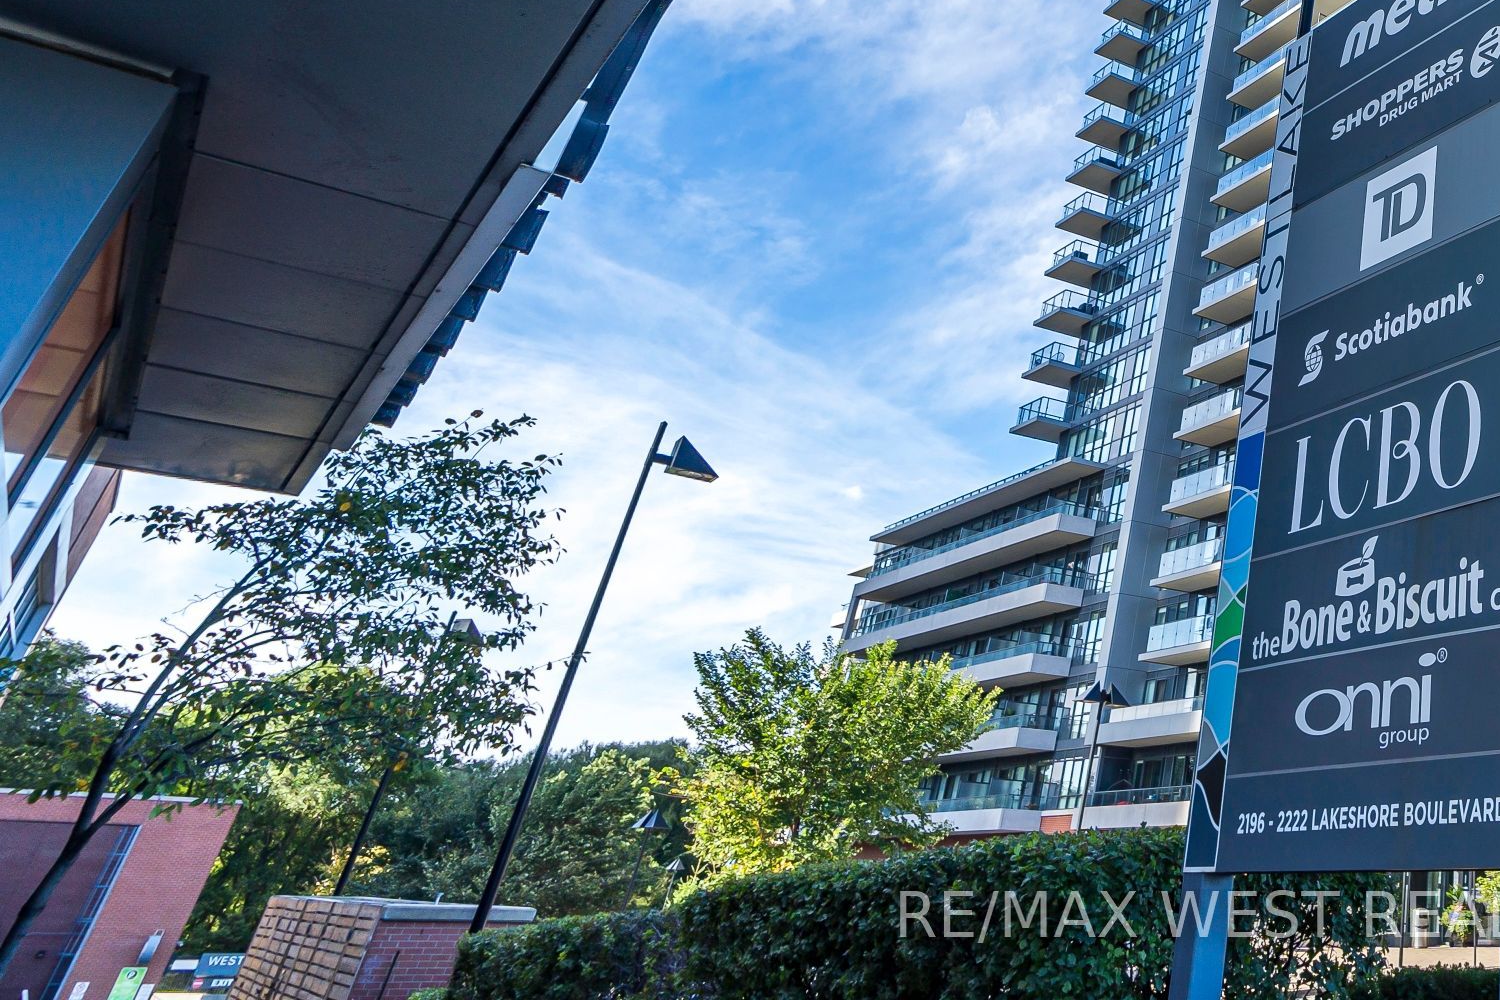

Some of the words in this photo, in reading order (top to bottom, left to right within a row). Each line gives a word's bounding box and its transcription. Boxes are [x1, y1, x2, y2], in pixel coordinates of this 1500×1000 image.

[1330, 47, 1464, 141] SHOPPERS
[1378, 98, 1419, 128] DRUG
[1421, 69, 1463, 102] MART
[1241, 34, 1312, 428] WESTLAKE
[1372, 176, 1427, 243] TD
[1334, 281, 1473, 361] Scotiabank
[1287, 379, 1482, 535] LCBO
[1252, 629, 1280, 661] the
[1281, 598, 1351, 655] Bone
[1356, 608, 1373, 635] &
[1375, 556, 1486, 636] Biscuit
[1294, 652, 1437, 737] onni
[1379, 725, 1430, 750] group
[1237, 810, 1265, 835] 2196
[1276, 807, 1308, 833] 2222
[1311, 801, 1399, 831] LAKESHORE
[208, 955, 245, 966] WEST
[210, 979, 234, 987] EXIT
